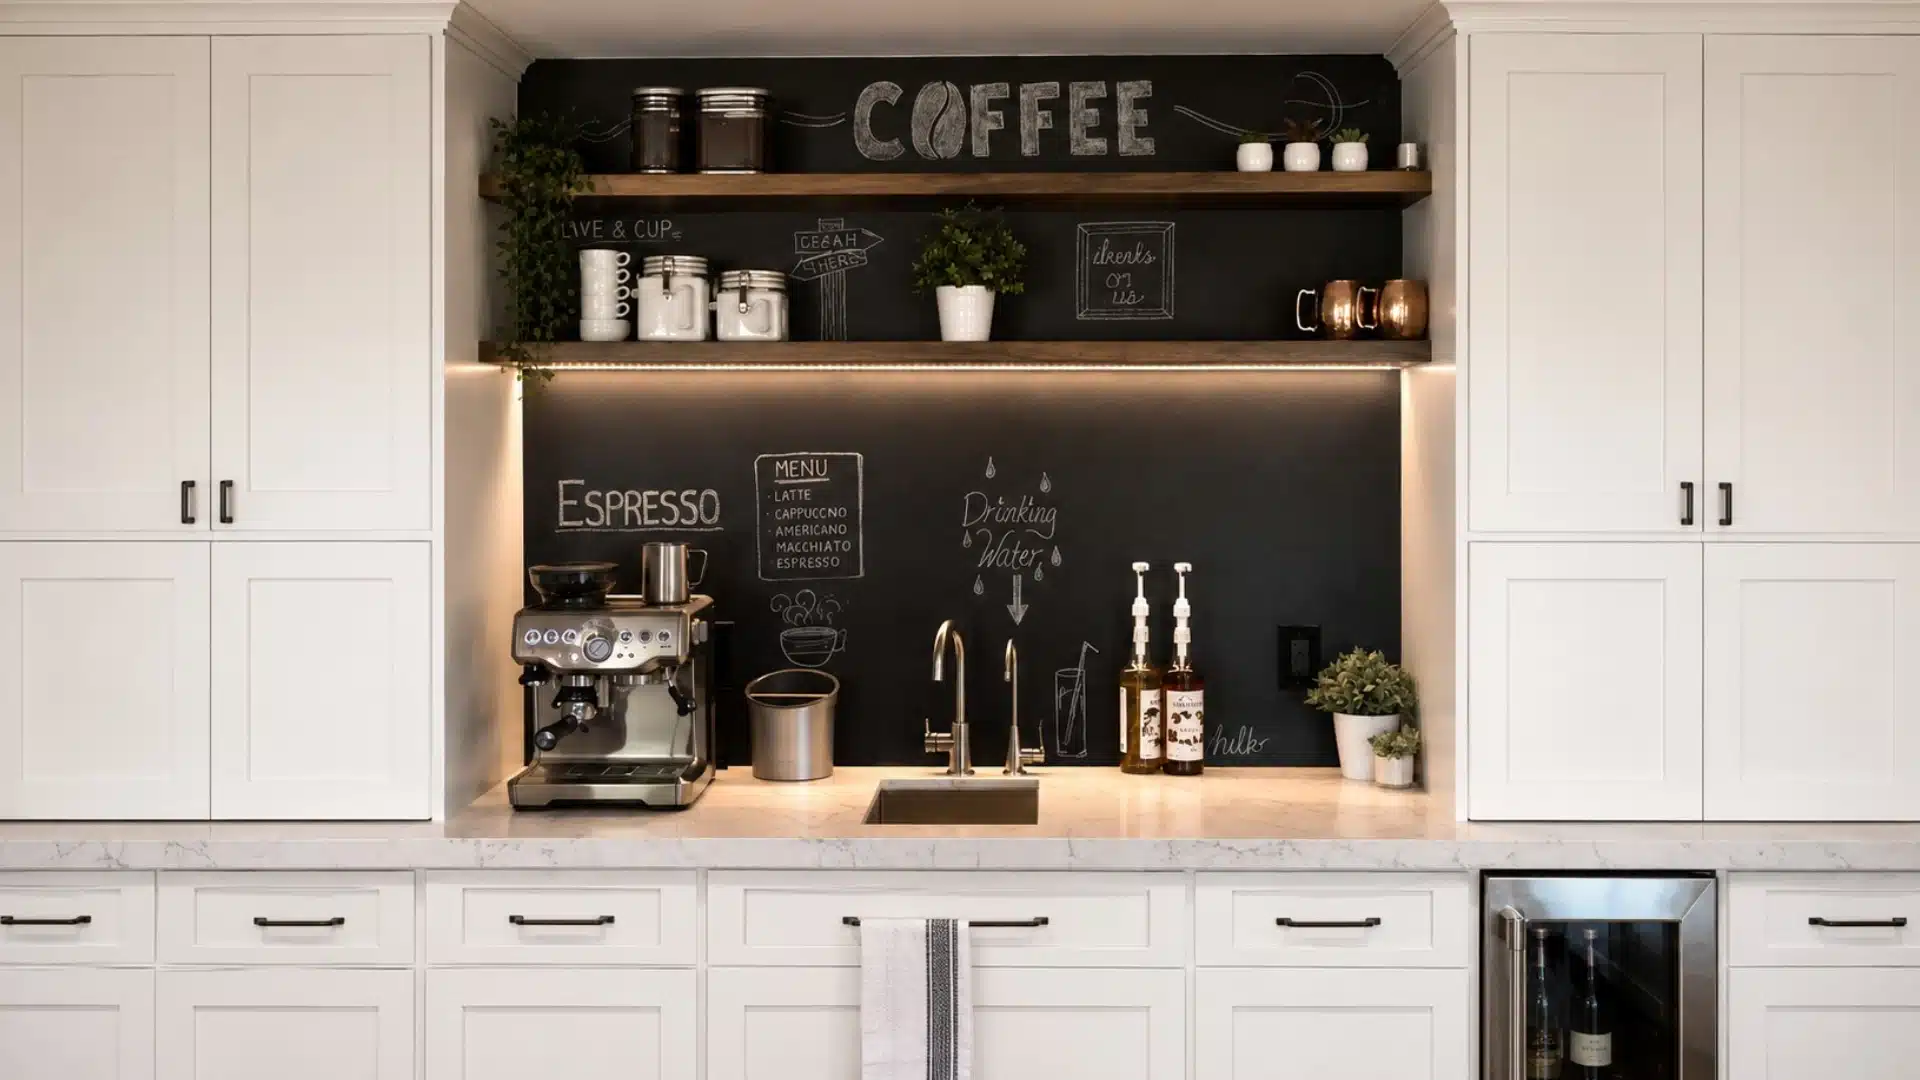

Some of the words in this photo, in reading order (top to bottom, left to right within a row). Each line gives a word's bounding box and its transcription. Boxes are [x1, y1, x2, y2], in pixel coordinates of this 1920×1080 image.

[853, 80, 1156, 161] COFFEE
[612, 219, 626, 239] &
[775, 458, 828, 478] MENU
[774, 488, 812, 502] LATTE
[962, 490, 1057, 540] Drinking
[775, 523, 848, 537] AMERICANO
[776, 540, 852, 553] MACCHIATO
[976, 527, 1044, 570] Water
[776, 556, 841, 569] ESPRESSO
